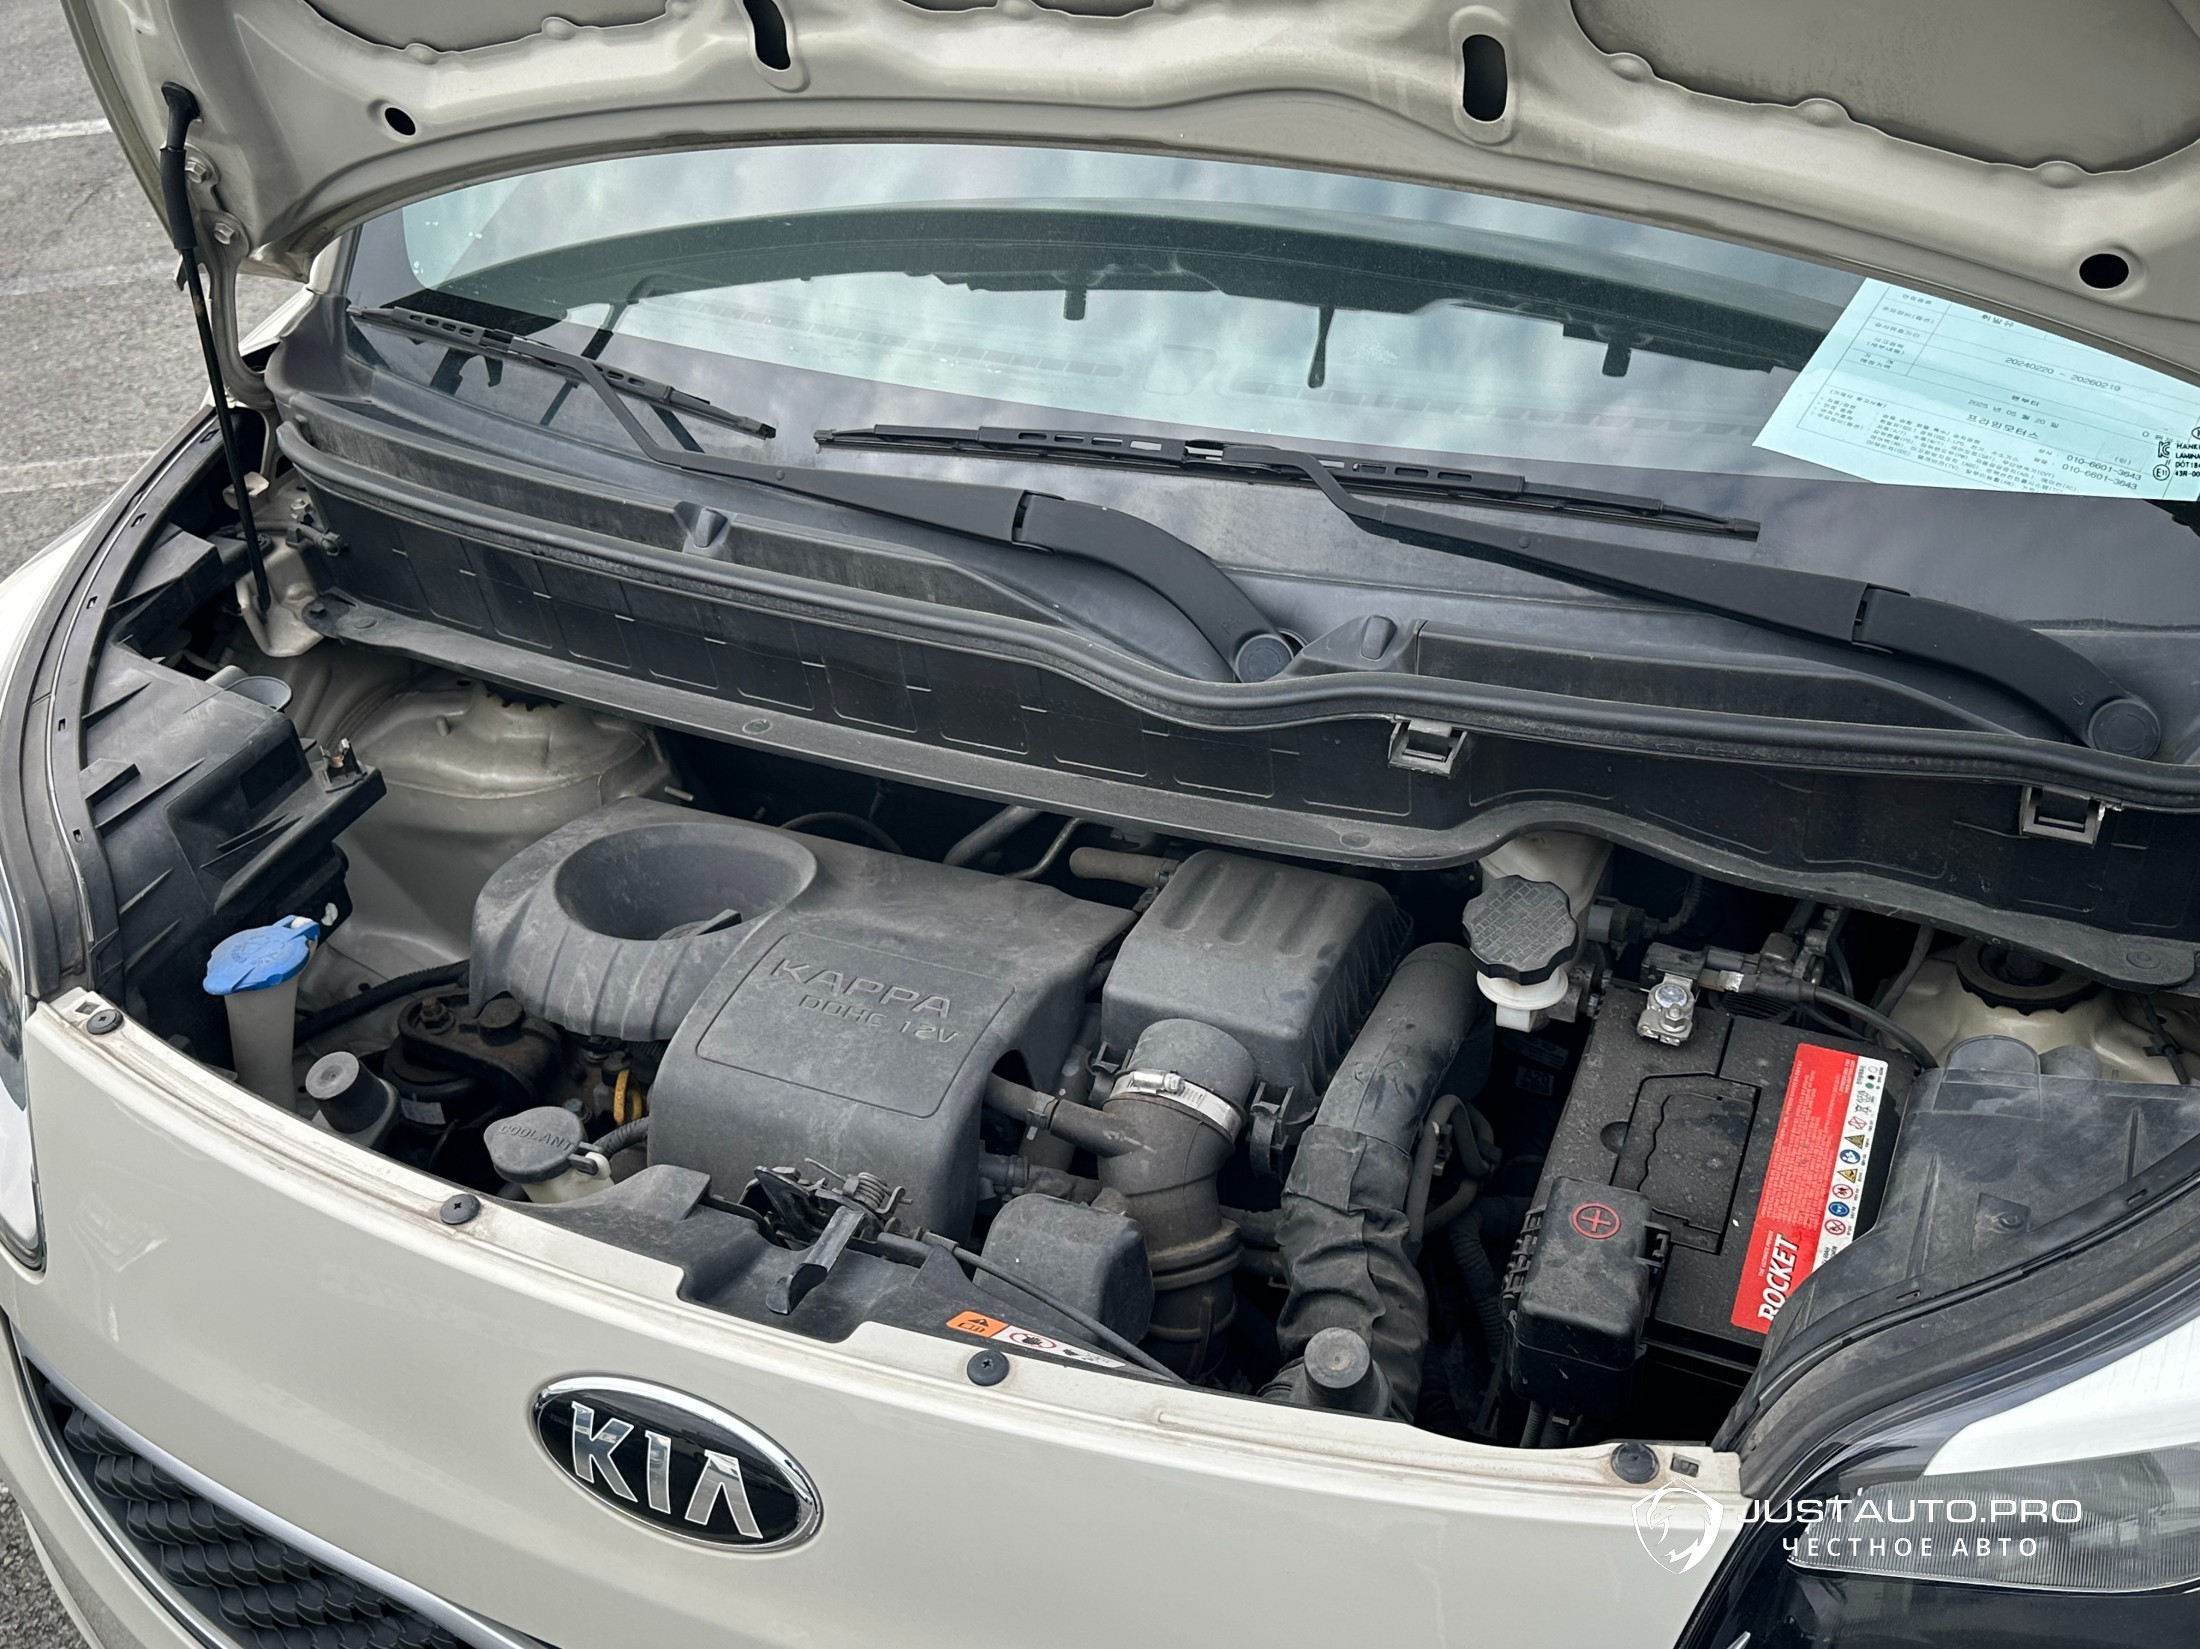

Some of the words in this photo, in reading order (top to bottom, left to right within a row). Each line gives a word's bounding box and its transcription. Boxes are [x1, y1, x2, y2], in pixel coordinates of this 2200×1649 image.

[2005, 358, 2054, 374] 20240220
[2071, 375, 2121, 391] 20260219
[1968, 415, 2038, 439] 프라임모터스
[2062, 463, 2138, 490] 010-6601-3643
[2066, 455, 2142, 481] 010-6601-3643
[770, 958, 952, 1018] KAPPA
[798, 994, 888, 1028] DOHC
[900, 1019, 959, 1043] 12V
[499, 1123, 574, 1152] COOLANT
[1758, 1232, 1800, 1322] ROCKET
[572, 1400, 763, 1539] KIA
